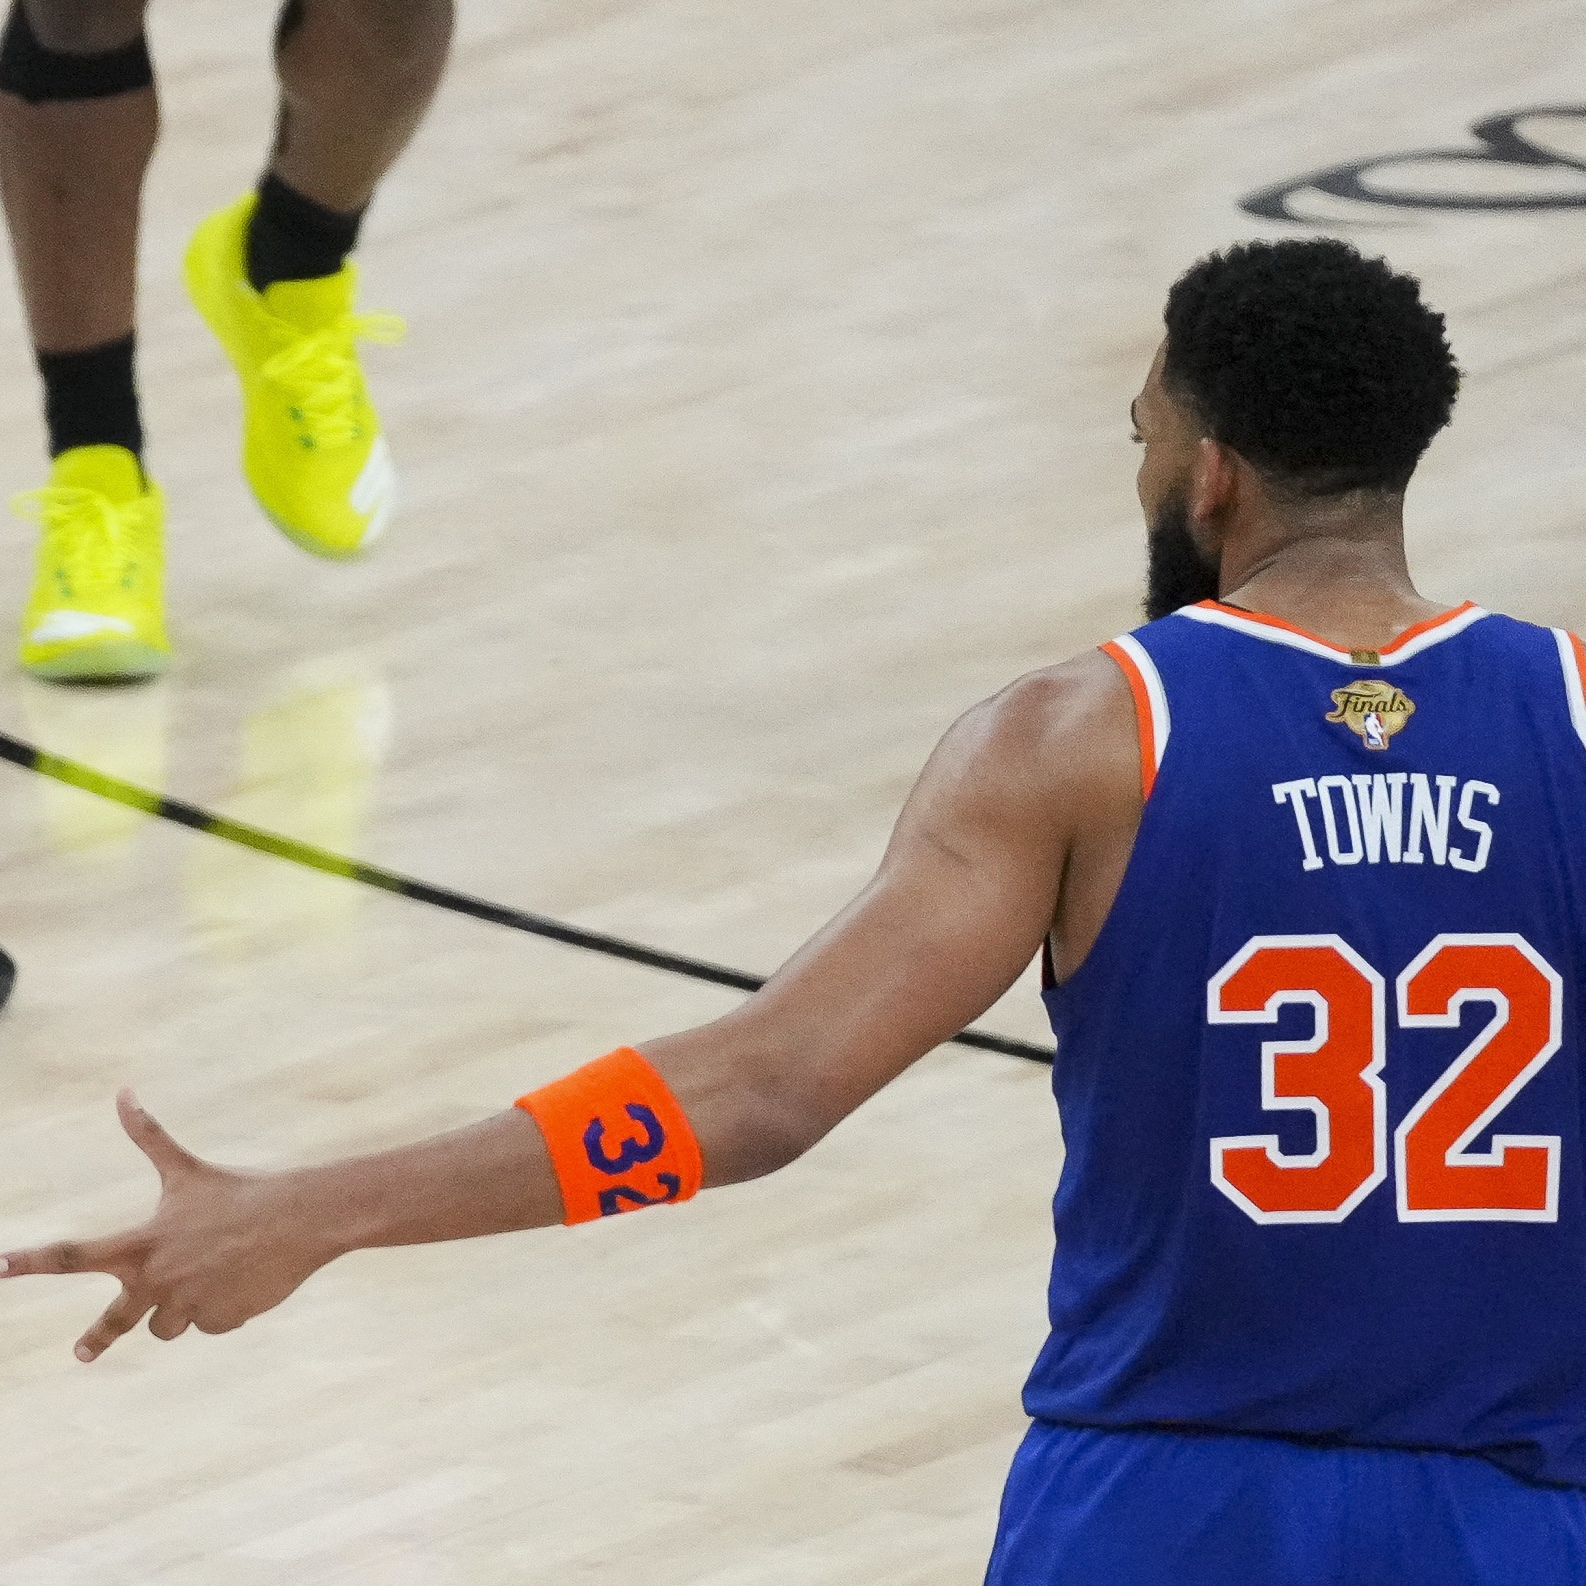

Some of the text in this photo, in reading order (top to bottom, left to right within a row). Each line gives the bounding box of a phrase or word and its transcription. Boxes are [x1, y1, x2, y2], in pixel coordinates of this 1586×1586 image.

[1333, 690, 1409, 719] Finals
[1272, 773, 1500, 873] TOWNS
[1207, 932, 1564, 1226] 32
[583, 1102, 681, 1217] 32
